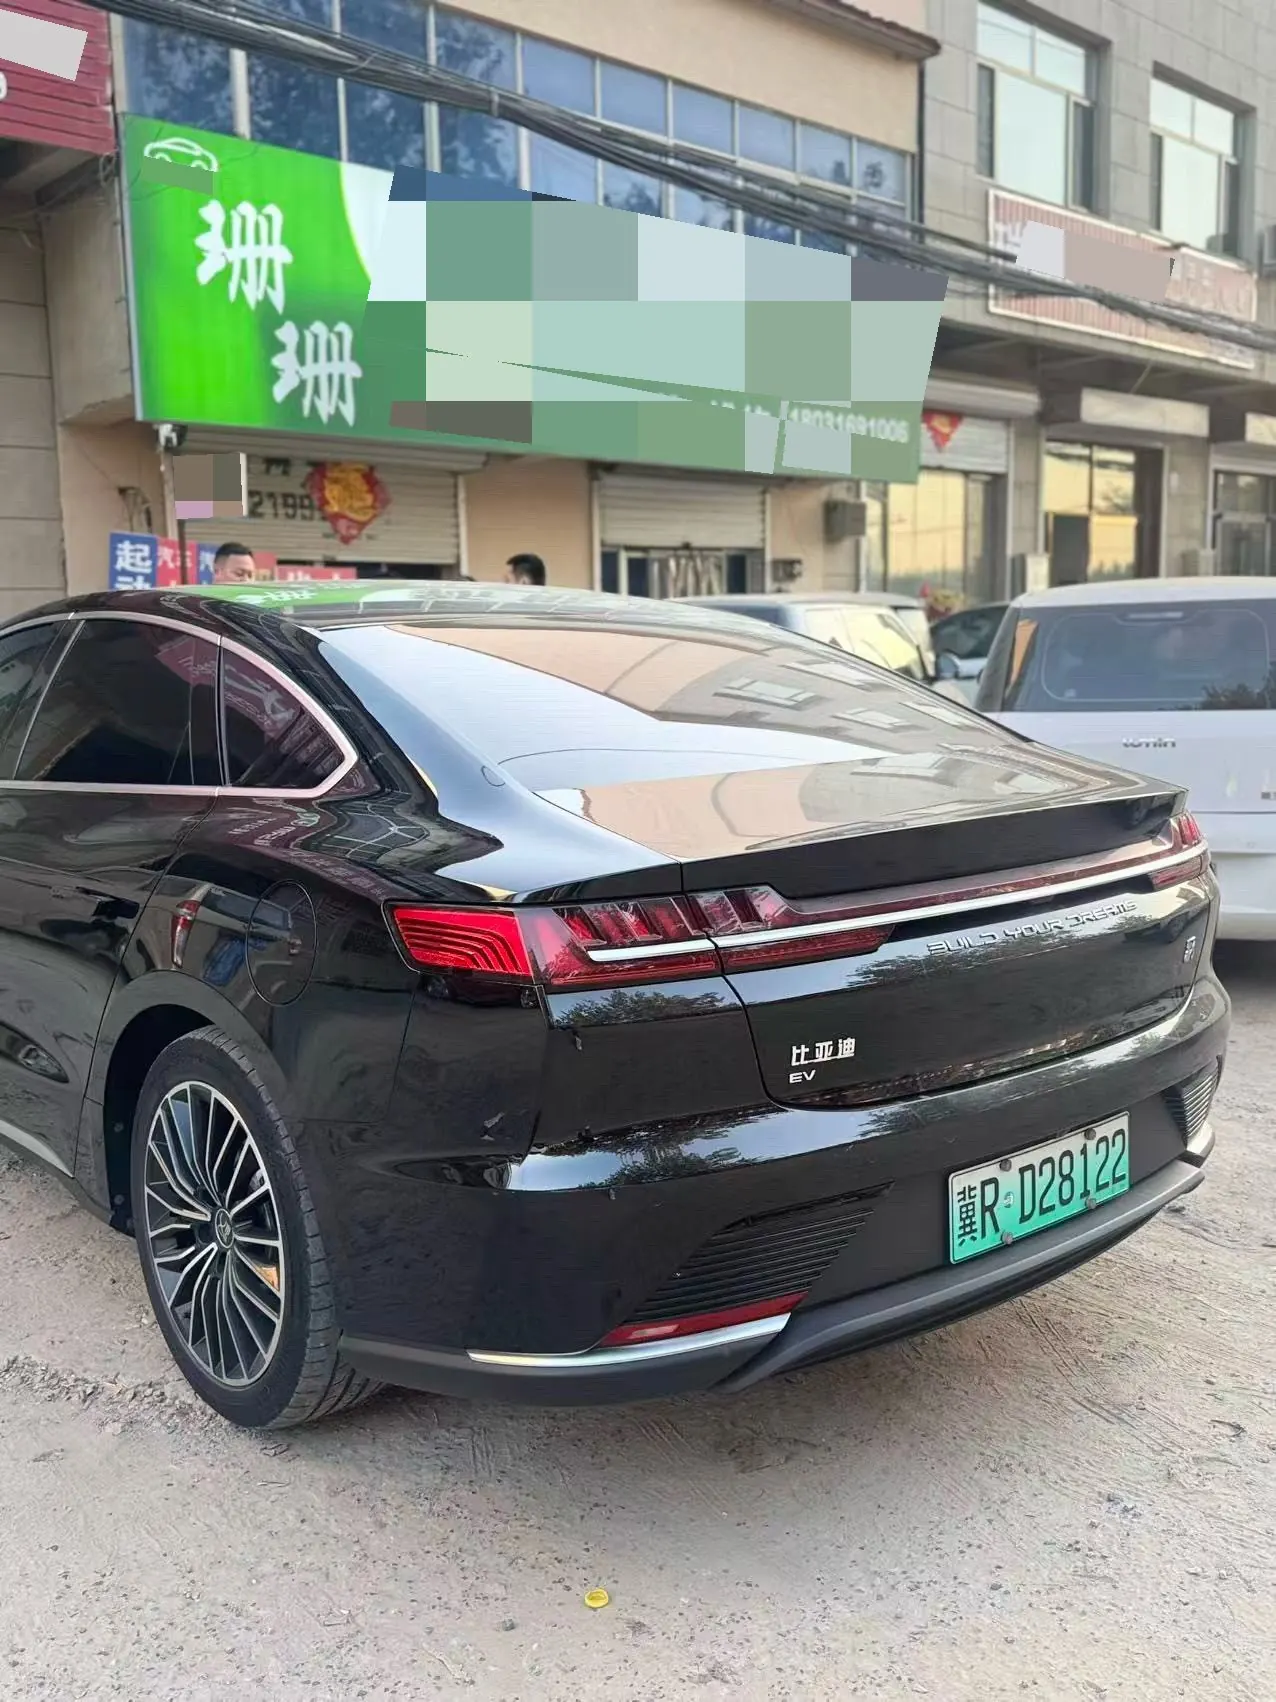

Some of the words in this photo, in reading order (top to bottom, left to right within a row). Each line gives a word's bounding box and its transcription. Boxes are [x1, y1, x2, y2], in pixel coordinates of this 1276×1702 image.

[927, 932, 998, 956] BUILD
[1003, 919, 1064, 940] YOUR
[1065, 901, 1138, 928] DREAMS
[791, 1037, 856, 1067] 比亚迪
[789, 1069, 816, 1084] EV
